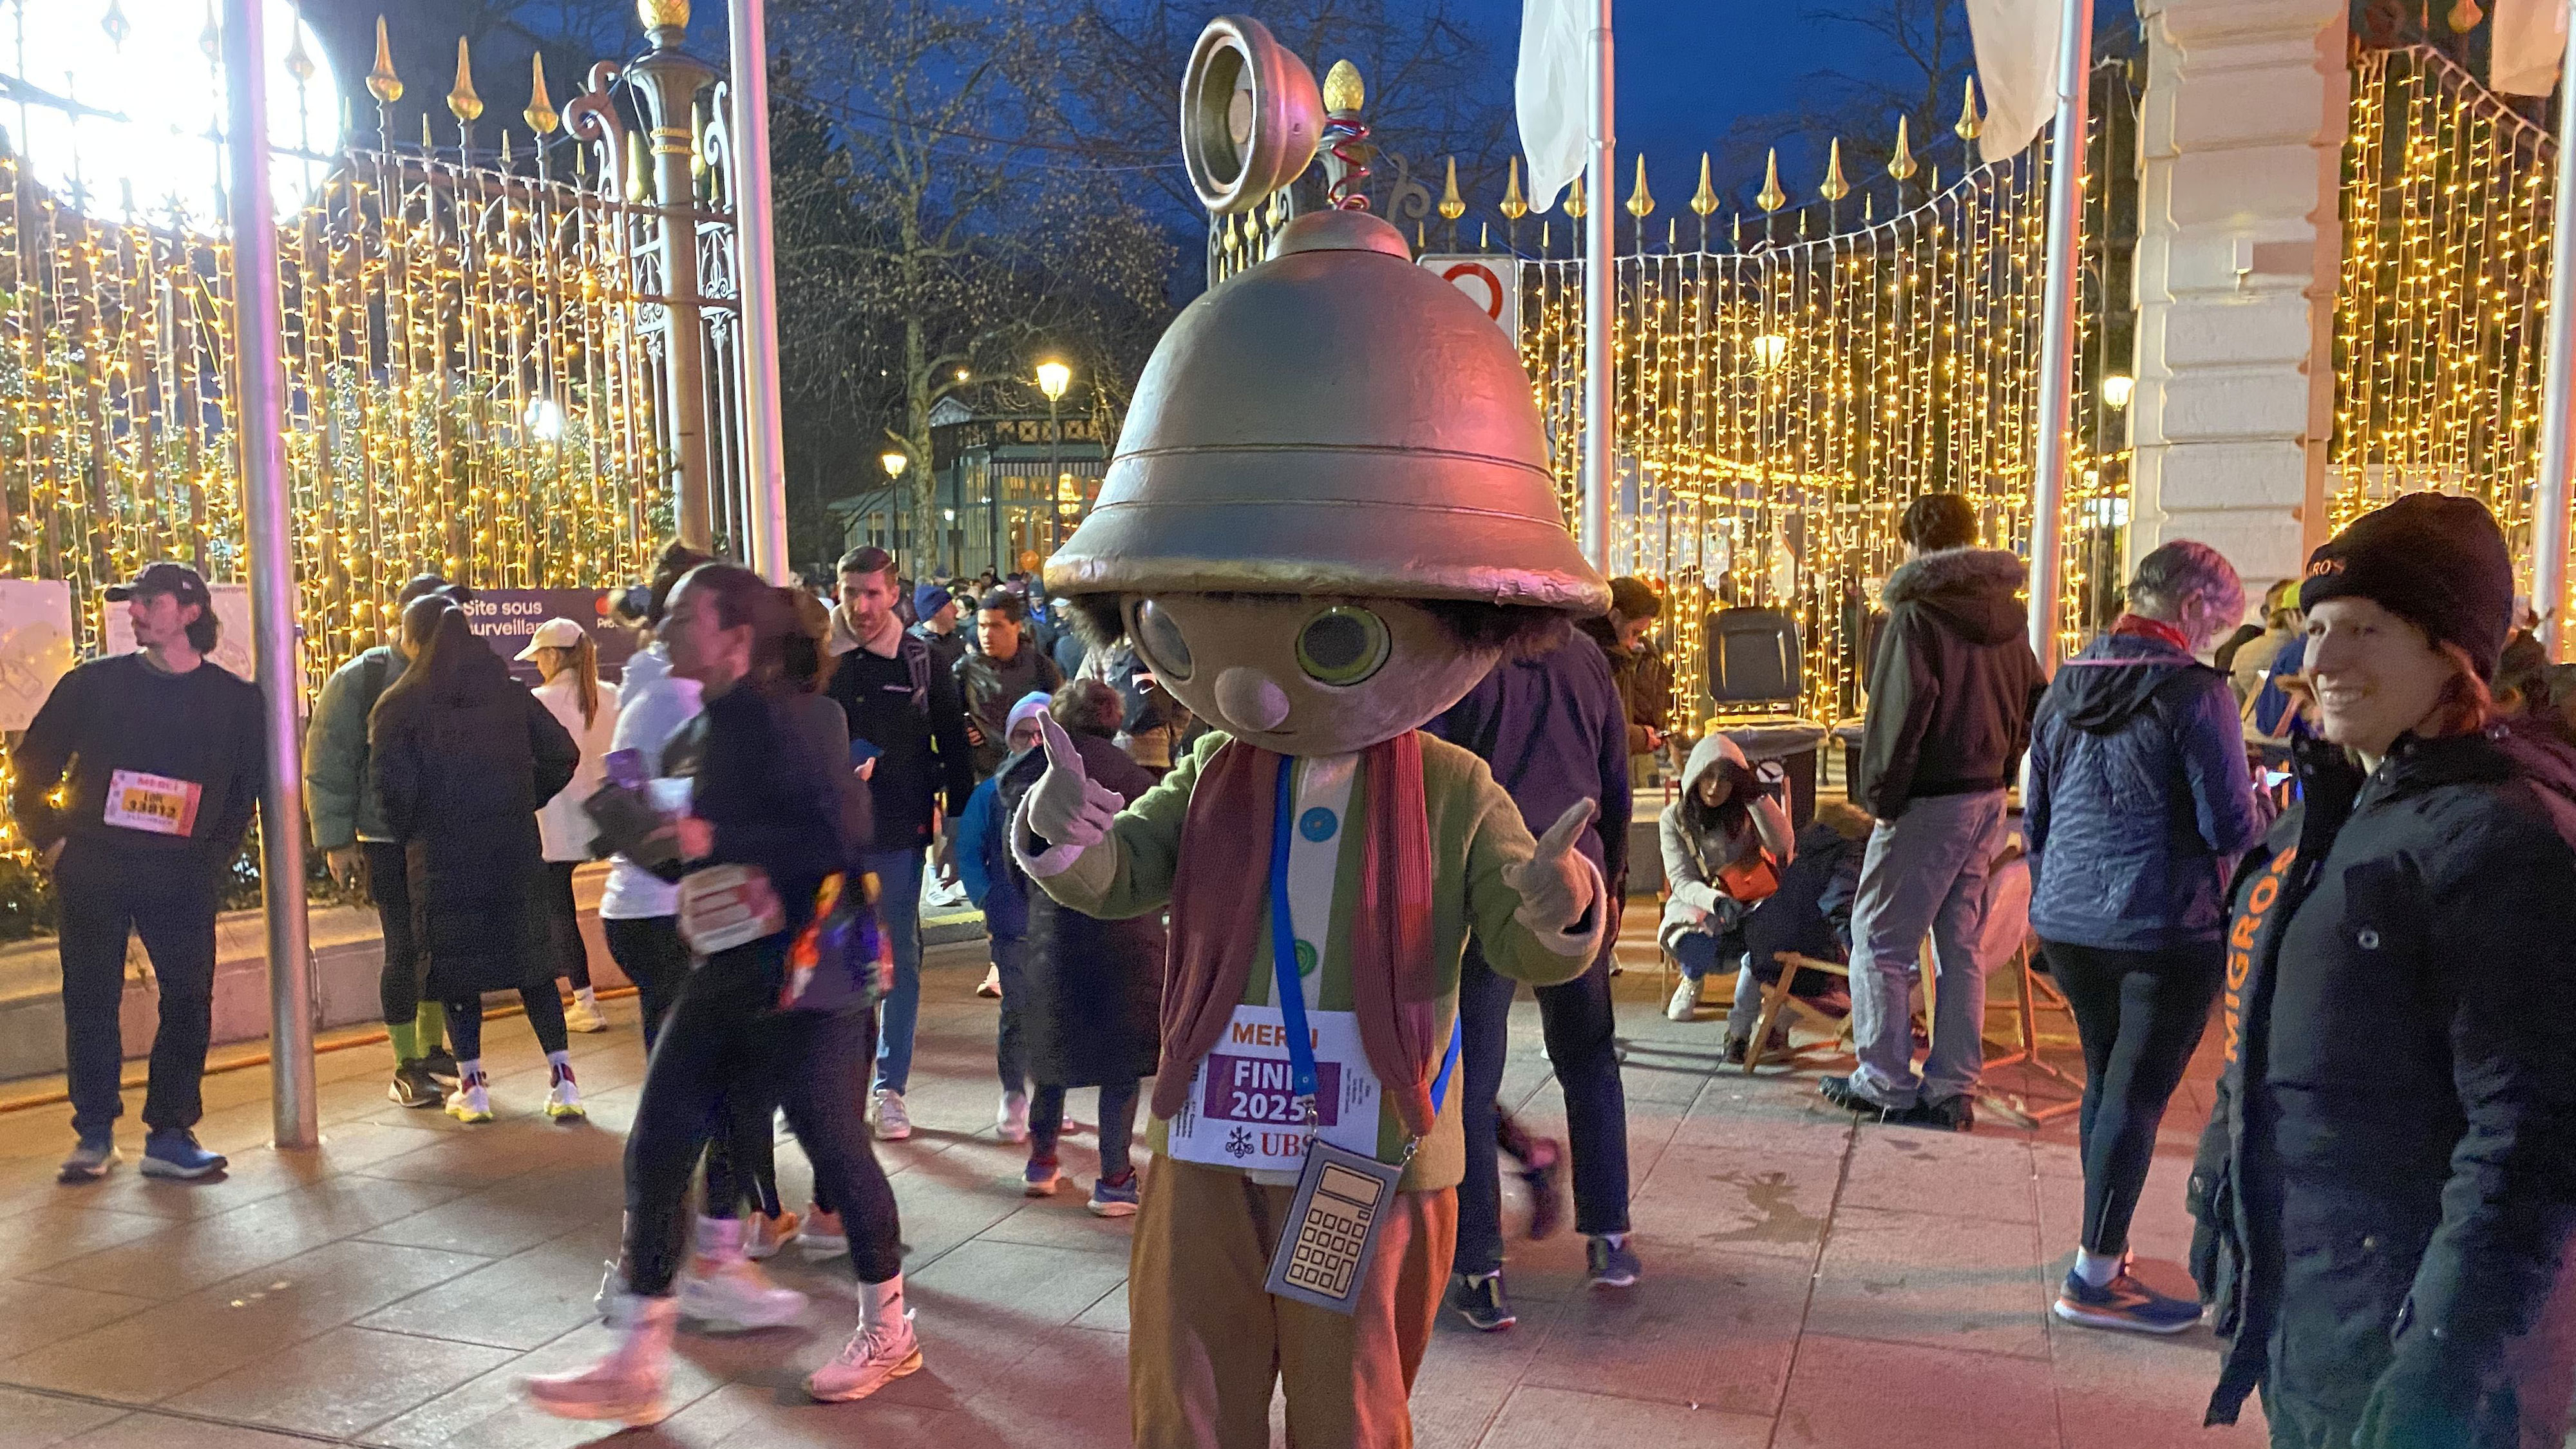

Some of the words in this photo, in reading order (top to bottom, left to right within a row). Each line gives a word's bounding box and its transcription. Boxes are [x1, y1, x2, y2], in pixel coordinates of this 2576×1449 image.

[502, 601, 542, 615] sous
[1233, 1022, 1318, 1050] MERI
[1230, 1091, 1307, 1122] 2025
